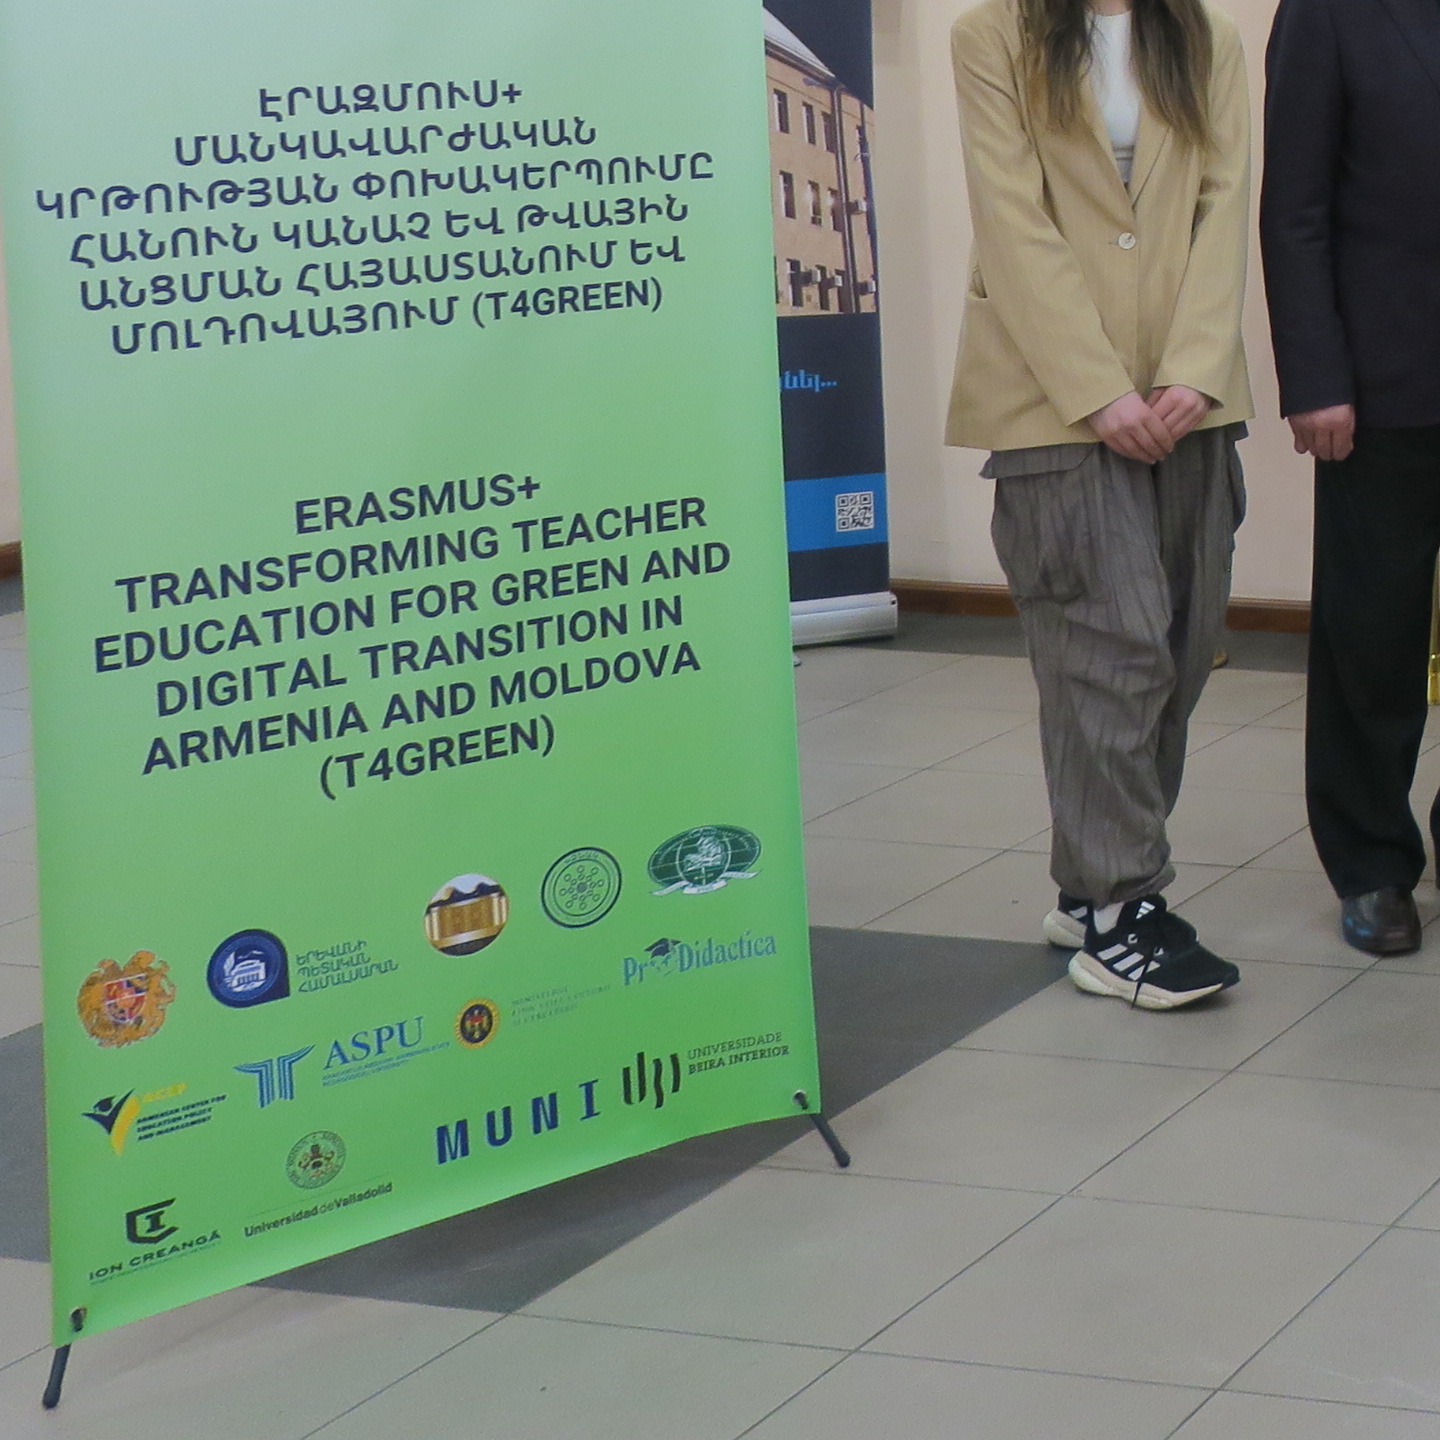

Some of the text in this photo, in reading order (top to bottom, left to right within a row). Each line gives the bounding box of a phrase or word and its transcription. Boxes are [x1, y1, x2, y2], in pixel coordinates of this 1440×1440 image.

[259, 79, 522, 122] ԷՐԱԶՄՈՒՍ+
[174, 116, 596, 166] ՄԱՆԿԱՎԱՐԺԱԿԱՆ
[36, 152, 714, 219] ԿՐԹՈՒԹՅԱՆ ՓՈԽԱԿԵՐՊՈՒՄԸ
[69, 193, 689, 269] ՀԱՆՈՒՆ ԿԱՆԱՉ ԵՎ ԹՎԱՅԻՆ
[80, 235, 686, 311] ԱՆՑՄԱՆ ՀԱՅԱՍՏԱՆՈՒՄ ԵՎ
[112, 276, 663, 355] ՄՈԼԴՈՎԱՅՈՒՄ (T4GREEN)
[296, 473, 541, 535] ERASMUS+
[114, 497, 707, 613] TRANSFORMING TEACHER
[94, 541, 731, 673] EDUCATION FOR GREEN AND
[156, 594, 683, 718] DIGITAL TRANSITION IN
[142, 641, 702, 776] ARMENIA AND MOLDOVA
[320, 714, 555, 801] (T4GREEN)
[323, 1016, 424, 1070] ASPU
[687, 1032, 783, 1060] UNIVERSIDADE
[688, 1045, 790, 1075] BEIRA INTERIOR
[436, 1078, 601, 1165] MUNI
[89, 1262, 123, 1281] ION
